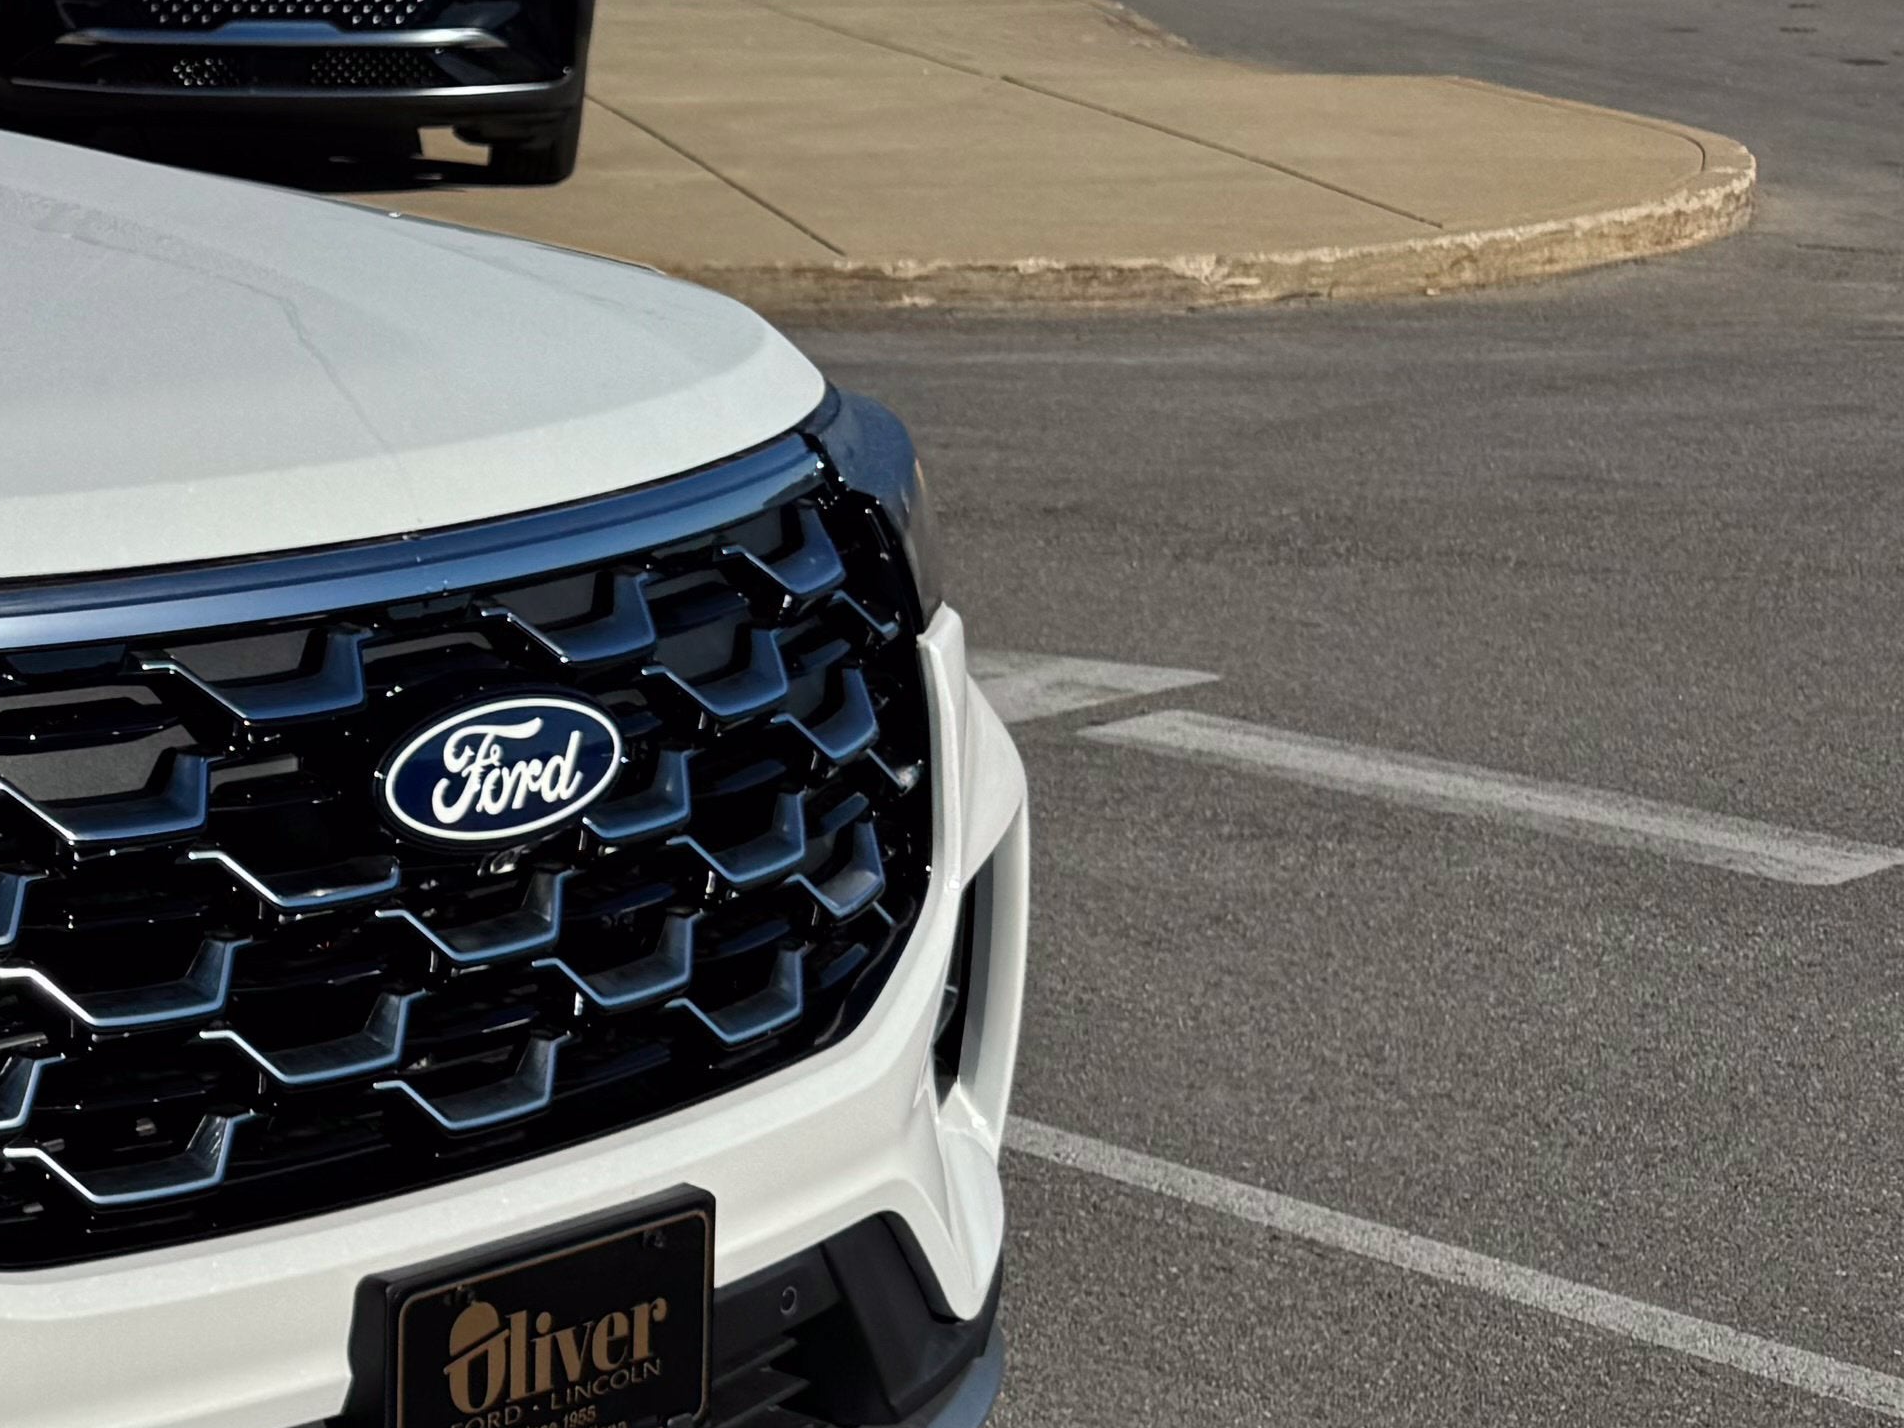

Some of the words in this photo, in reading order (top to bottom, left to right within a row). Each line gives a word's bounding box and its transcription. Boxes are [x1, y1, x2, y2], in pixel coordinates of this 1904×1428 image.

[431, 716, 585, 825] Ford
[443, 1296, 669, 1415] Oliver
[550, 1359, 661, 1411] LINCOLN
